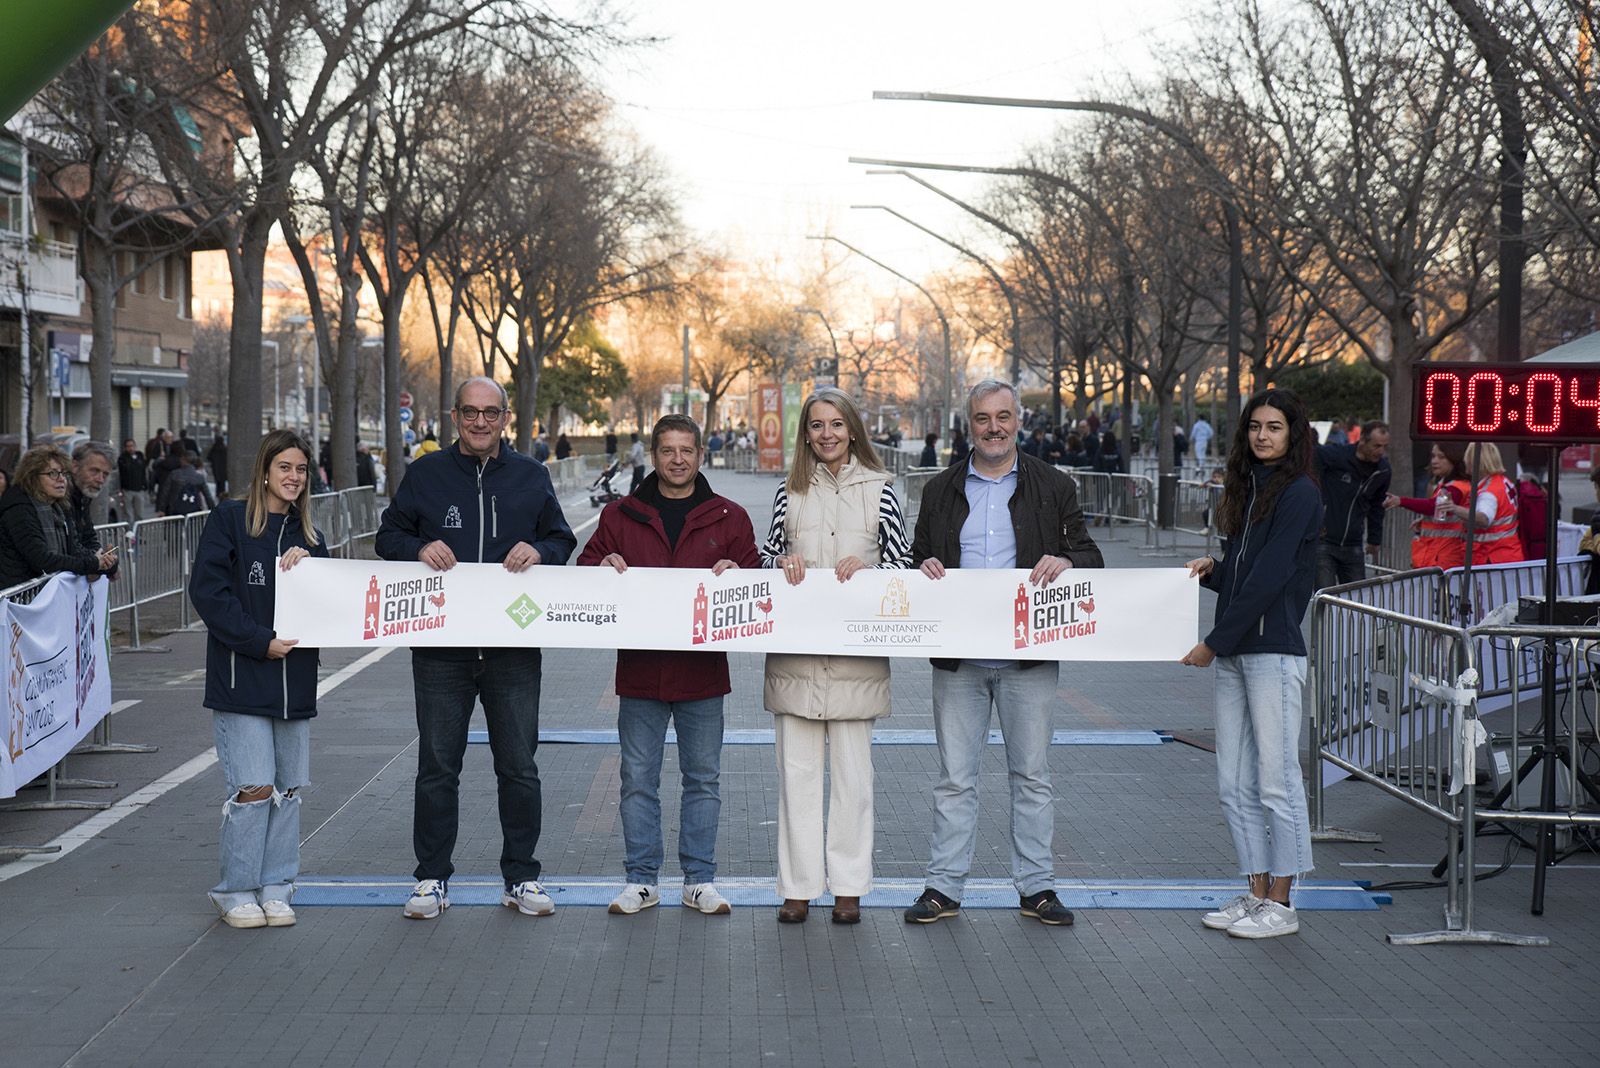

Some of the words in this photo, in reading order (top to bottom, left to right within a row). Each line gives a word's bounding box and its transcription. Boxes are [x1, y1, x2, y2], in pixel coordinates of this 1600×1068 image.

[385, 579, 422, 599] CURSA
[425, 575, 445, 593] DEL
[712, 585, 749, 606] CURSA
[752, 581, 772, 599] DEL
[1033, 585, 1071, 607] CURSA
[1074, 581, 1094, 599] DEL
[383, 595, 429, 622] GALL
[546, 602, 605, 612] AJUNTAMENT
[606, 604, 617, 612] DE
[546, 611, 617, 626] SantCugat
[712, 602, 757, 629] GALL
[1033, 602, 1080, 630] GALL
[382, 620, 411, 637] SANT
[411, 614, 447, 632] CUGAT
[711, 626, 739, 642] SANT
[740, 620, 774, 638] CUGAT
[846, 623, 870, 633] CLUB
[871, 623, 939, 633] MUNTANYENC
[1033, 627, 1061, 645] SANT
[1062, 620, 1097, 640] CUGAT
[863, 634, 888, 644] SANT
[889, 634, 922, 644] CUGAT
